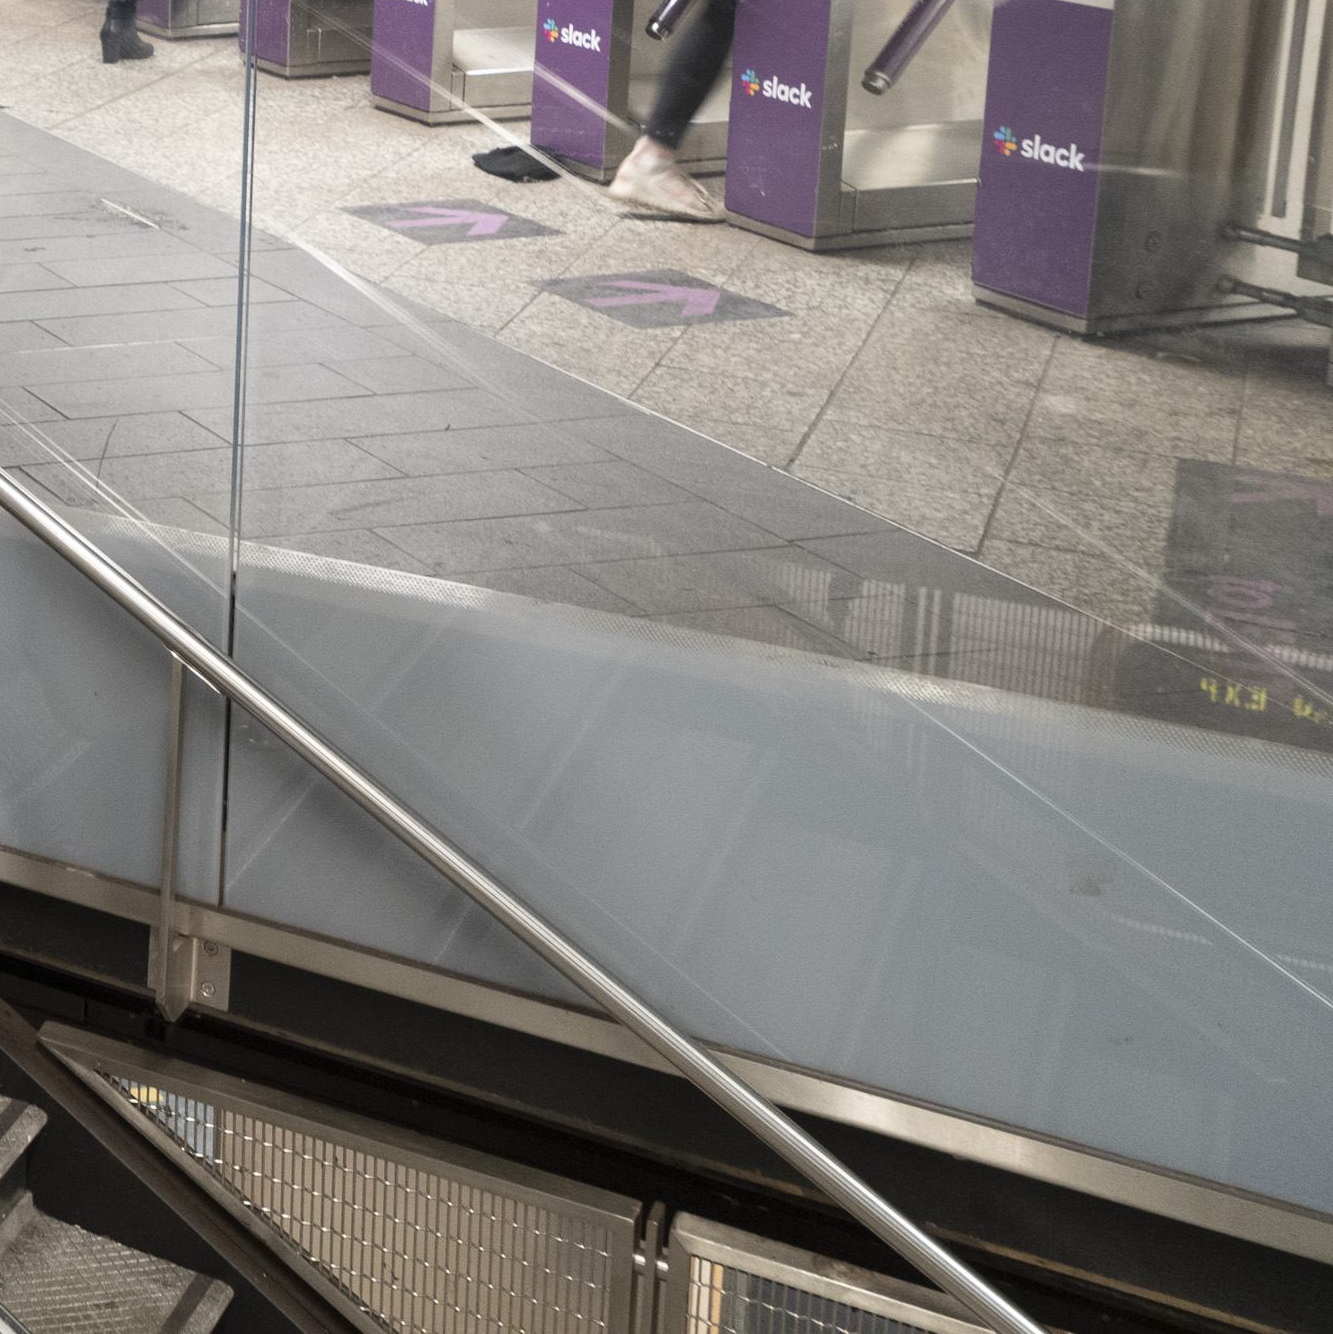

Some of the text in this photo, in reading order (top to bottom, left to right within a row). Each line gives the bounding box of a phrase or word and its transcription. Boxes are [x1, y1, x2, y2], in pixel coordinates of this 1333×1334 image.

[560, 23, 601, 52] slack
[762, 75, 812, 109] slack
[1020, 133, 1085, 172] slack
